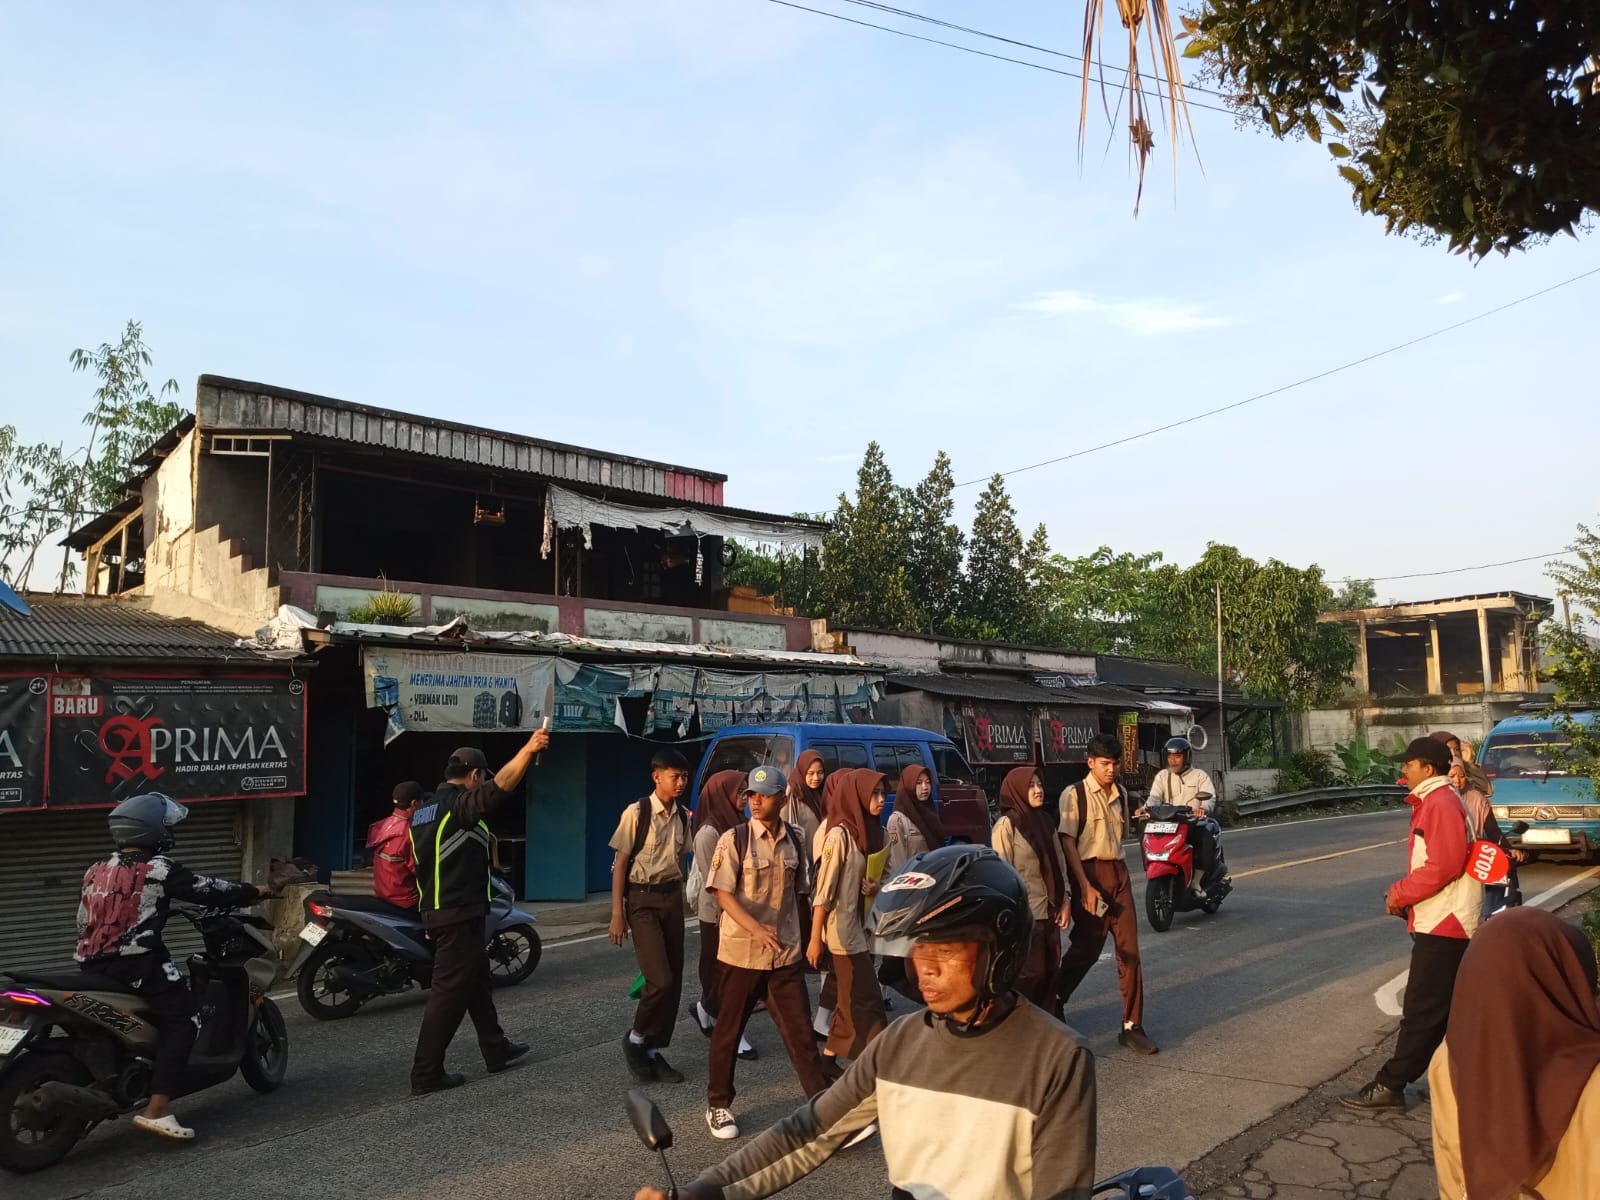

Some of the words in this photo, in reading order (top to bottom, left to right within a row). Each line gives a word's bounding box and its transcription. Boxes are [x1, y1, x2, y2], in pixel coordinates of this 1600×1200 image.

[410, 673, 445, 687] MENERIMA
[446, 674, 472, 688] JAHITAN
[474, 675, 487, 688] PRIA
[494, 677, 517, 689] WANITA
[54, 697, 98, 715] BARU
[414, 693, 440, 706] VERMAK
[175, 765, 199, 773] HADIR
[200, 763, 225, 772] DALAM
[226, 762, 259, 770] KEMASAN
[260, 760, 288, 769] KERTAS
[1473, 844, 1497, 881] STOP
